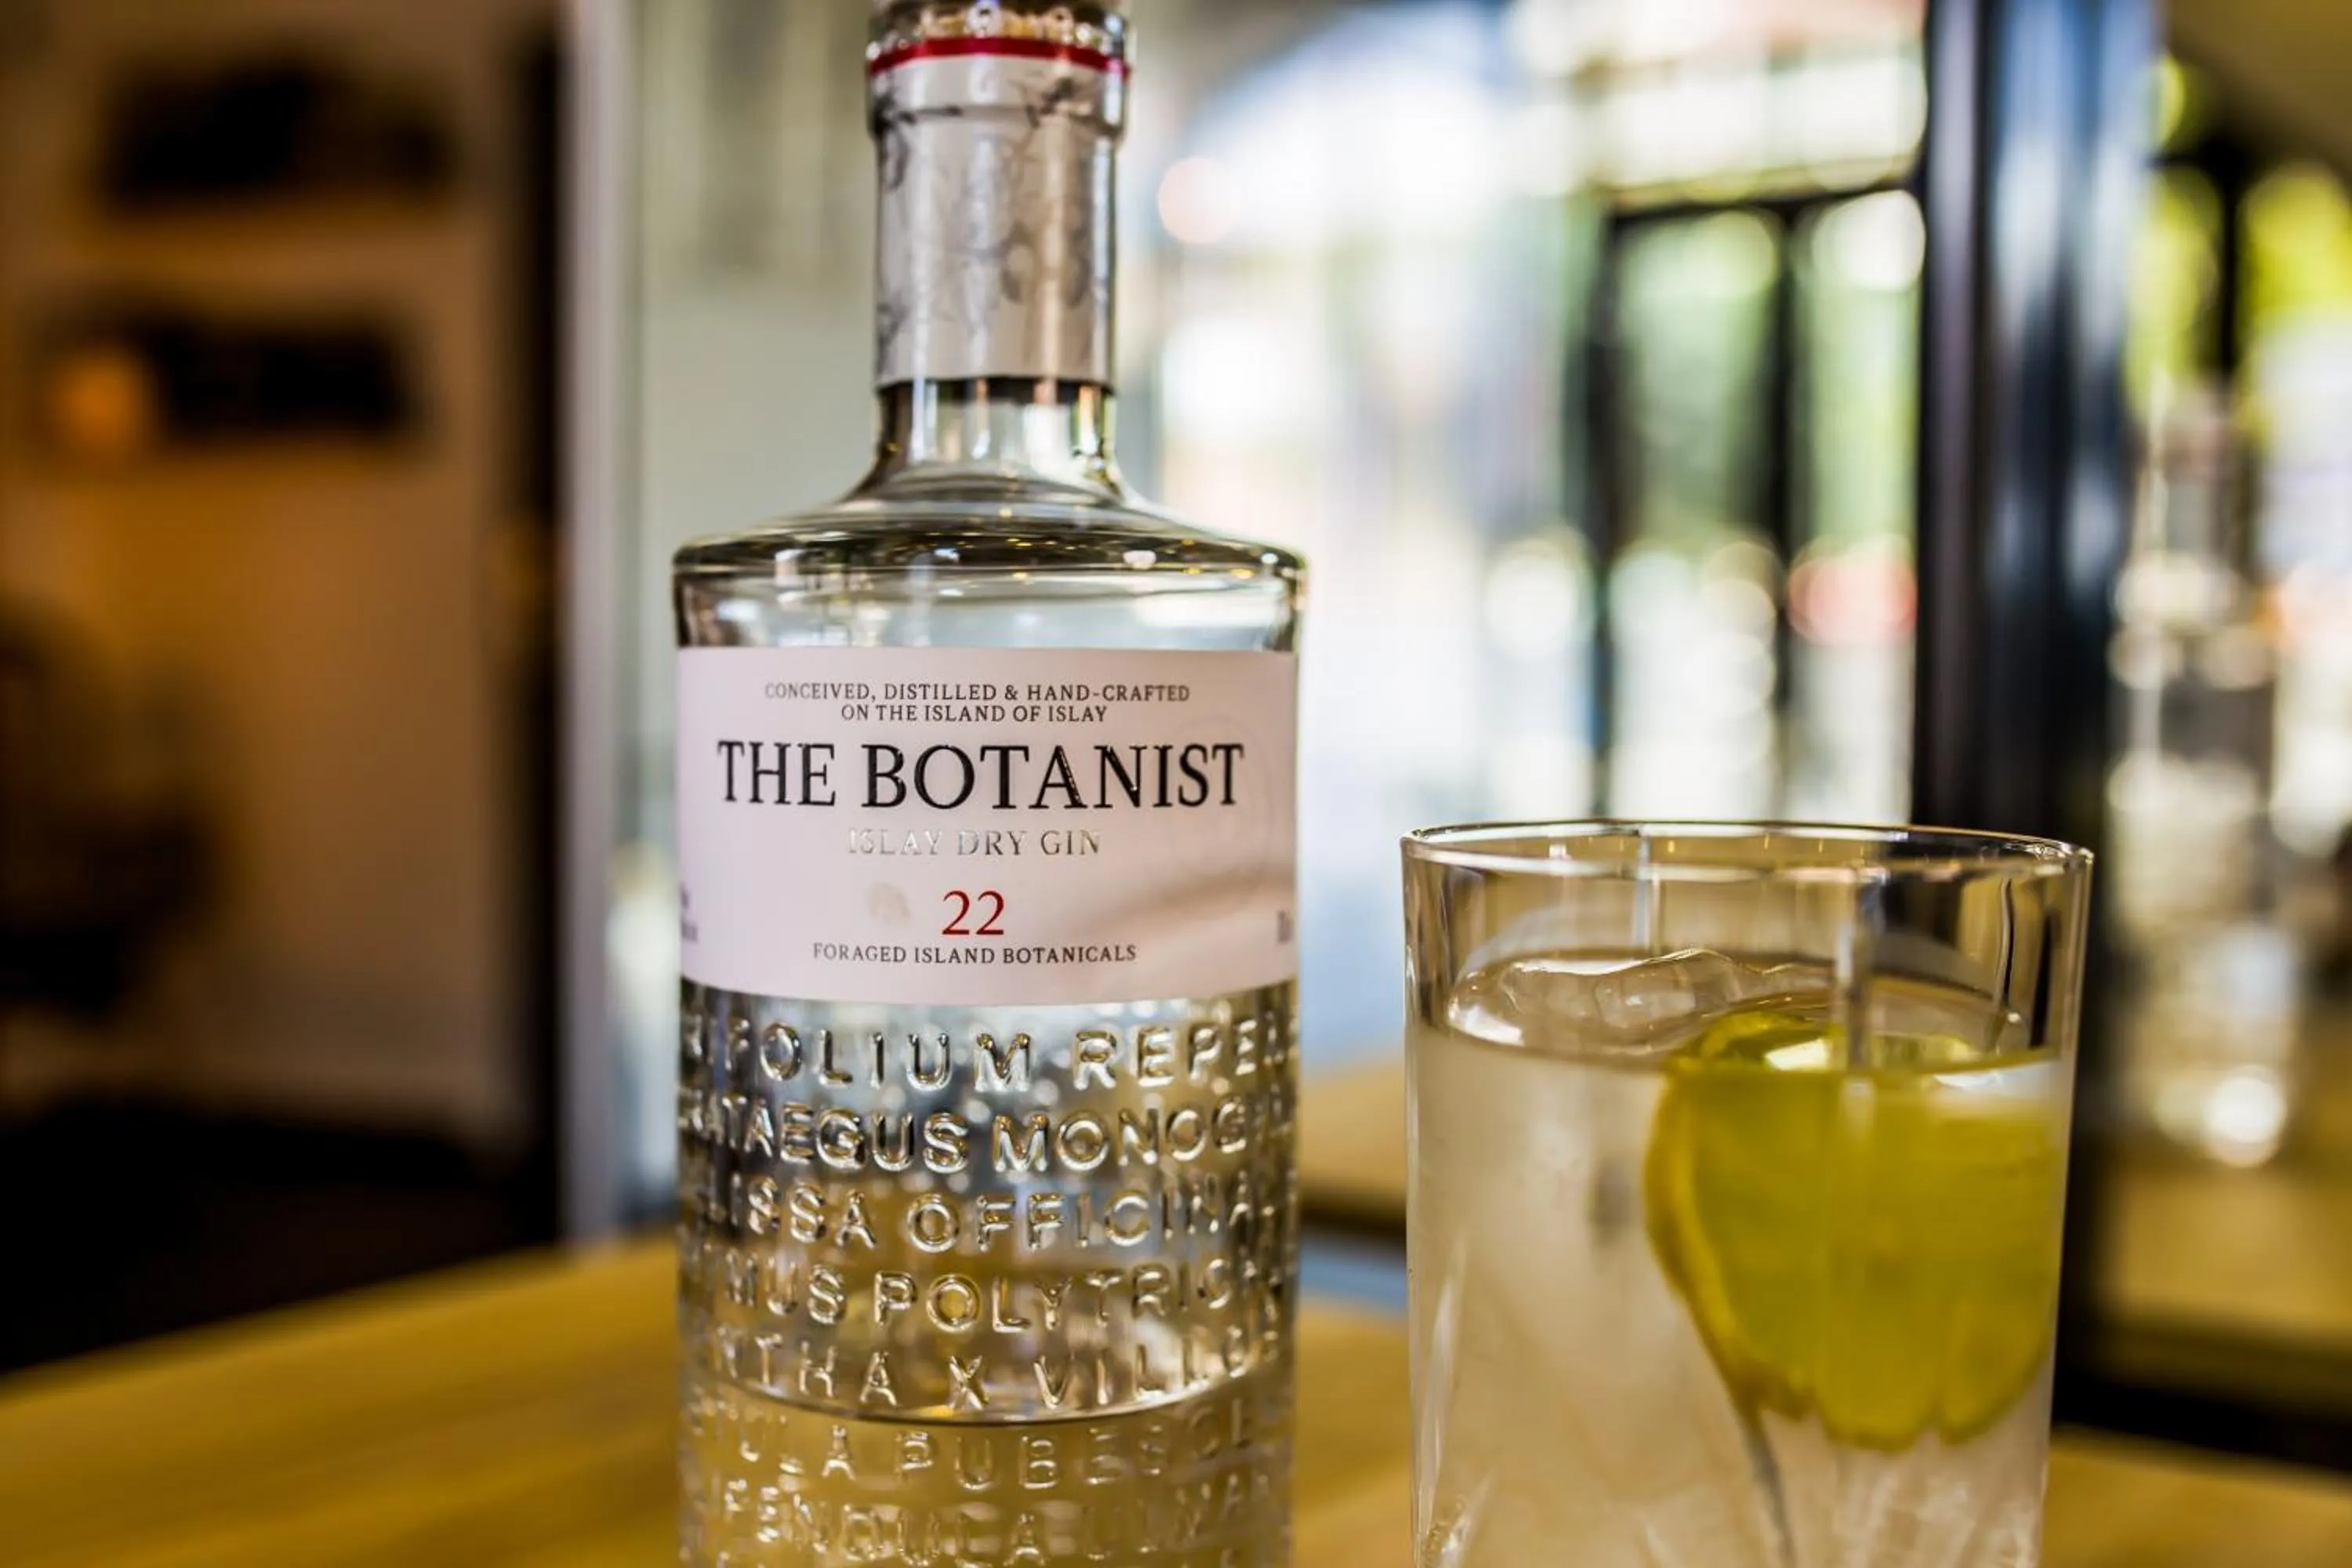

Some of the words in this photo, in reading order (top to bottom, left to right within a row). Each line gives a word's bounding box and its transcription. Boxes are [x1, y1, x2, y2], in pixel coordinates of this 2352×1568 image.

[764, 682, 876, 701] CONCEIVED,
[884, 684, 996, 701] DISTILLED
[1004, 685, 1018, 700] &
[1027, 684, 1190, 702] HAND-CRAFTED
[841, 704, 869, 720] ON
[876, 705, 917, 721] THE
[924, 705, 1006, 722] ISLAND
[1012, 705, 1041, 722] OF
[1048, 705, 1107, 722] ISLAY
[717, 740, 836, 807] THE
[861, 742, 1245, 810] BOTANIST
[848, 827, 942, 855] ISLAY
[956, 829, 1028, 856] DRY
[1040, 829, 1101, 855] GIN
[942, 889, 1005, 935] 22
[812, 942, 906, 964] FORAGED
[914, 946, 996, 965] ISLAND
[1003, 944, 1138, 965] BOTANICALS
[1073, 1016, 1279, 1091] REPE
[993, 1094, 1274, 1173] MONOG
